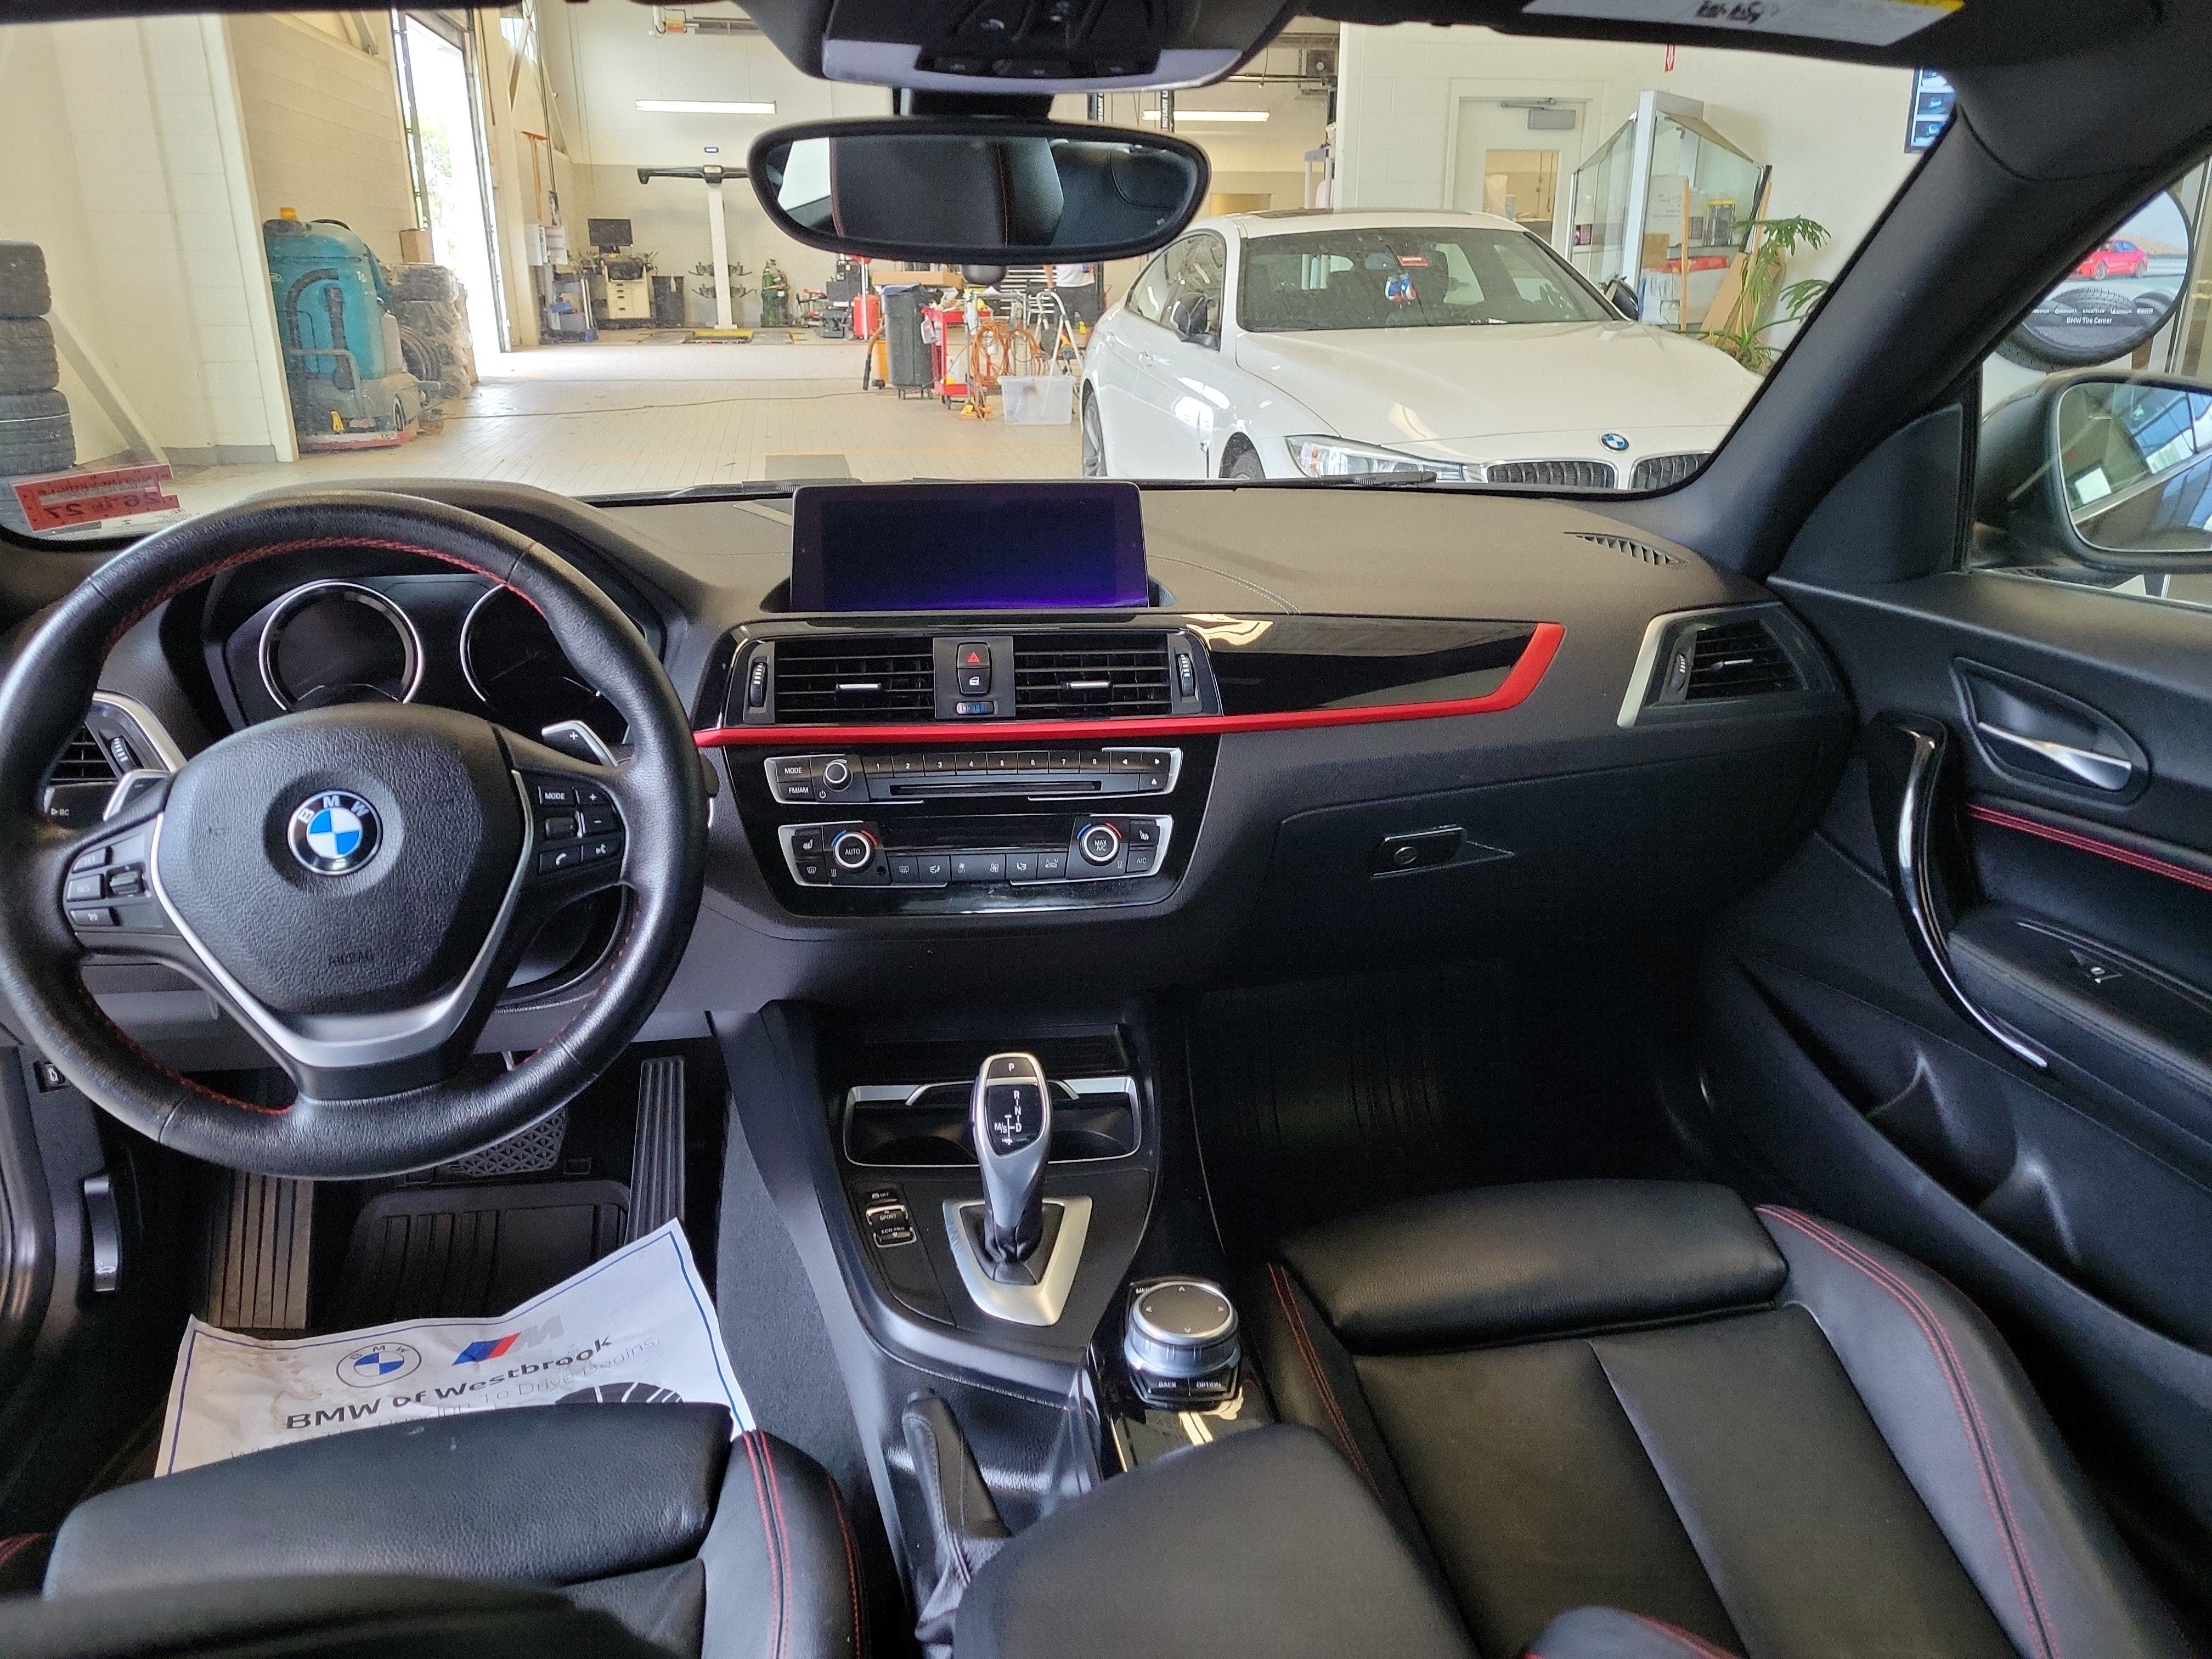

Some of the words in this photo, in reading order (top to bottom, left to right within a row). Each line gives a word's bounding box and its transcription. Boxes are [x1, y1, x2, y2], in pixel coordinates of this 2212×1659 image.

[544, 792, 566, 800] MODE
[297, 795, 369, 823] BMW
[1008, 1063, 1014, 1071] P
[1014, 1091, 1020, 1099] R
[1015, 1106, 1021, 1115] N
[994, 1122, 1007, 1134] M/S
[1015, 1123, 1022, 1132] D
[349, 1345, 410, 1359] BMW
[286, 1397, 382, 1429] BMW
[434, 1335, 612, 1400] Westbrook
[518, 1374, 574, 1395] Drive
